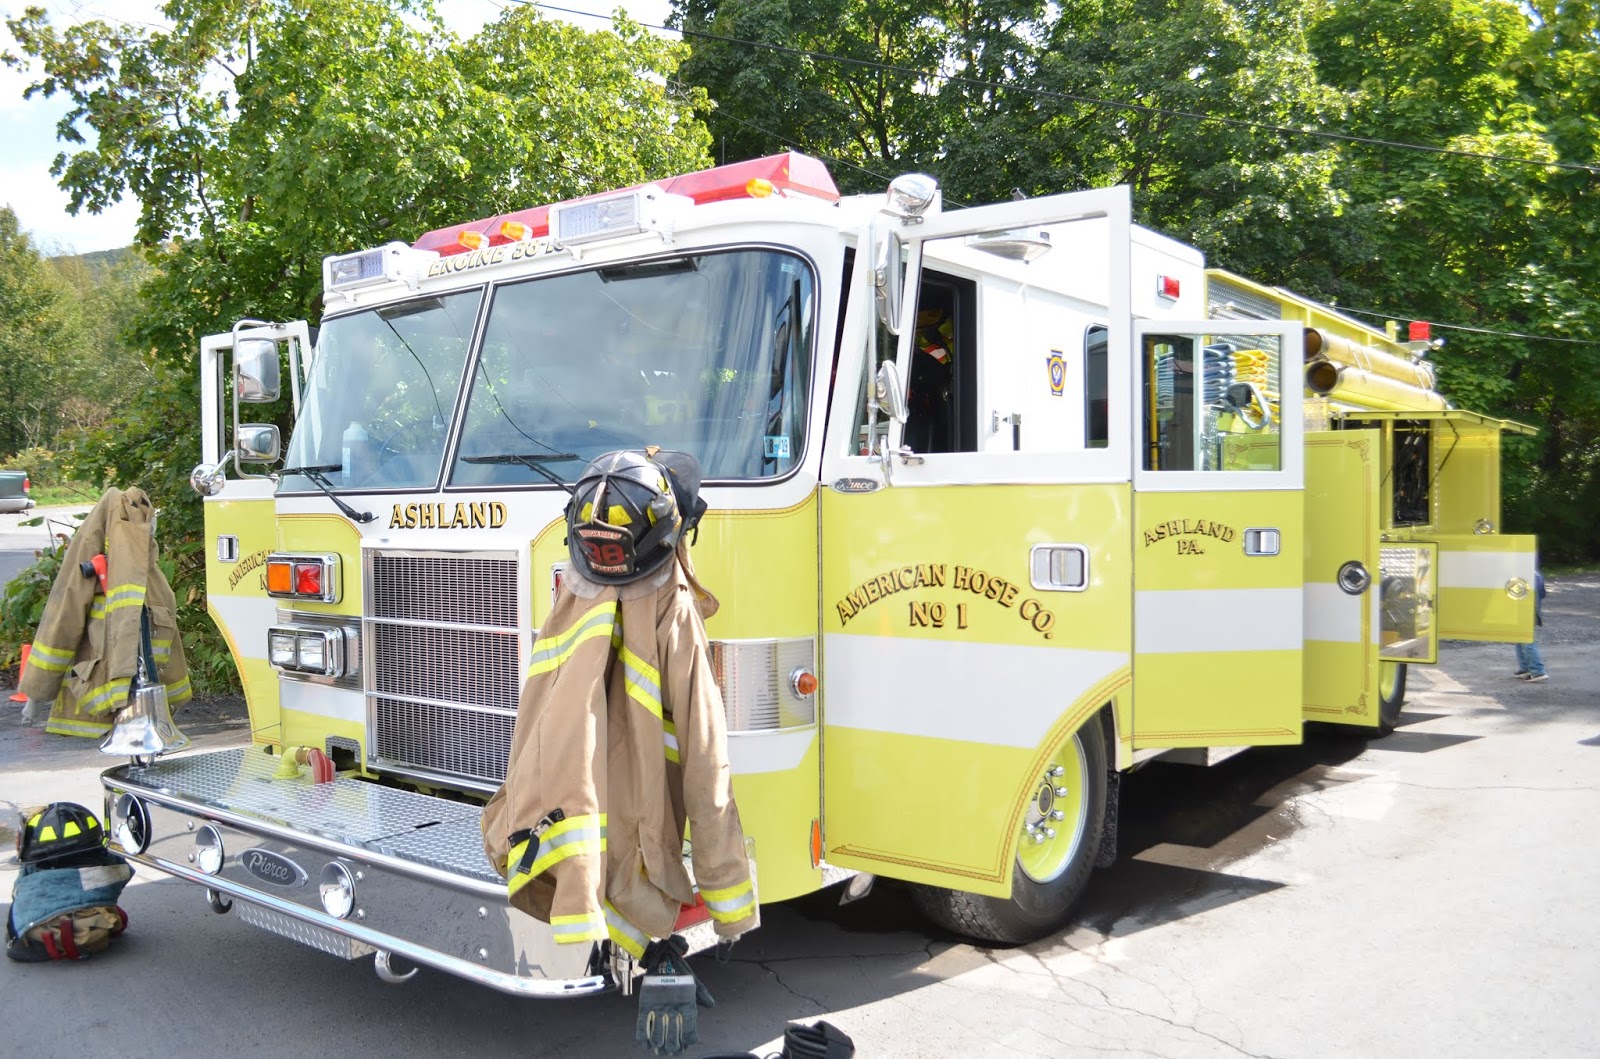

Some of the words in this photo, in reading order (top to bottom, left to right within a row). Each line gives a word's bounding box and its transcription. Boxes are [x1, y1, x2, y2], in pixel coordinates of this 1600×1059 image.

[428, 247, 505, 278] ENGINE
[389, 501, 508, 529] ASHLAND
[1143, 519, 1237, 547] ASHLAND
[1177, 539, 1205, 555] PA.
[582, 541, 624, 565] 38
[835, 563, 947, 627] AMERICAN
[953, 565, 1020, 608] HOSE
[1019, 599, 1056, 640] CO.
[957, 602, 968, 630] 1
[249, 852, 288, 880] Pierce
